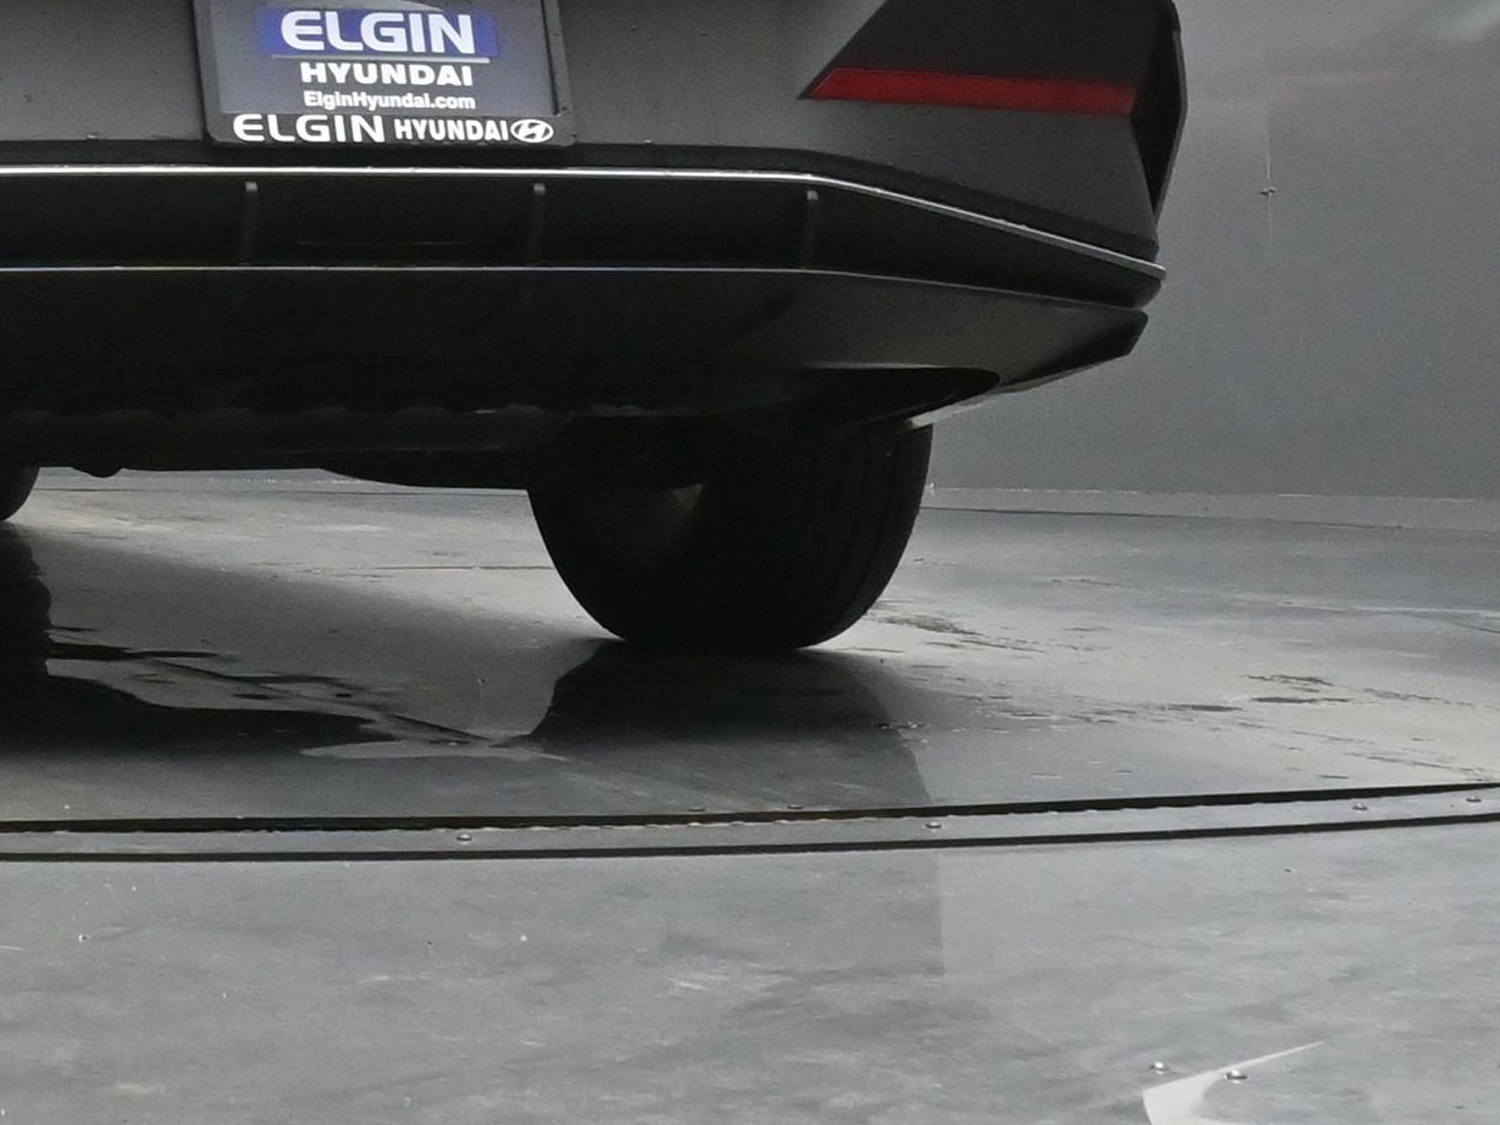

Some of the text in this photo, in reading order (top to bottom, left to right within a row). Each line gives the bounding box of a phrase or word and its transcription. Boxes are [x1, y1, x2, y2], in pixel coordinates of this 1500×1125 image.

[280, 10, 476, 55] ELGIN
[301, 62, 473, 87] HYUNDAI
[304, 90, 476, 111] ElginHyundai.com
[233, 113, 509, 143] ELGIN HYUNDAI
